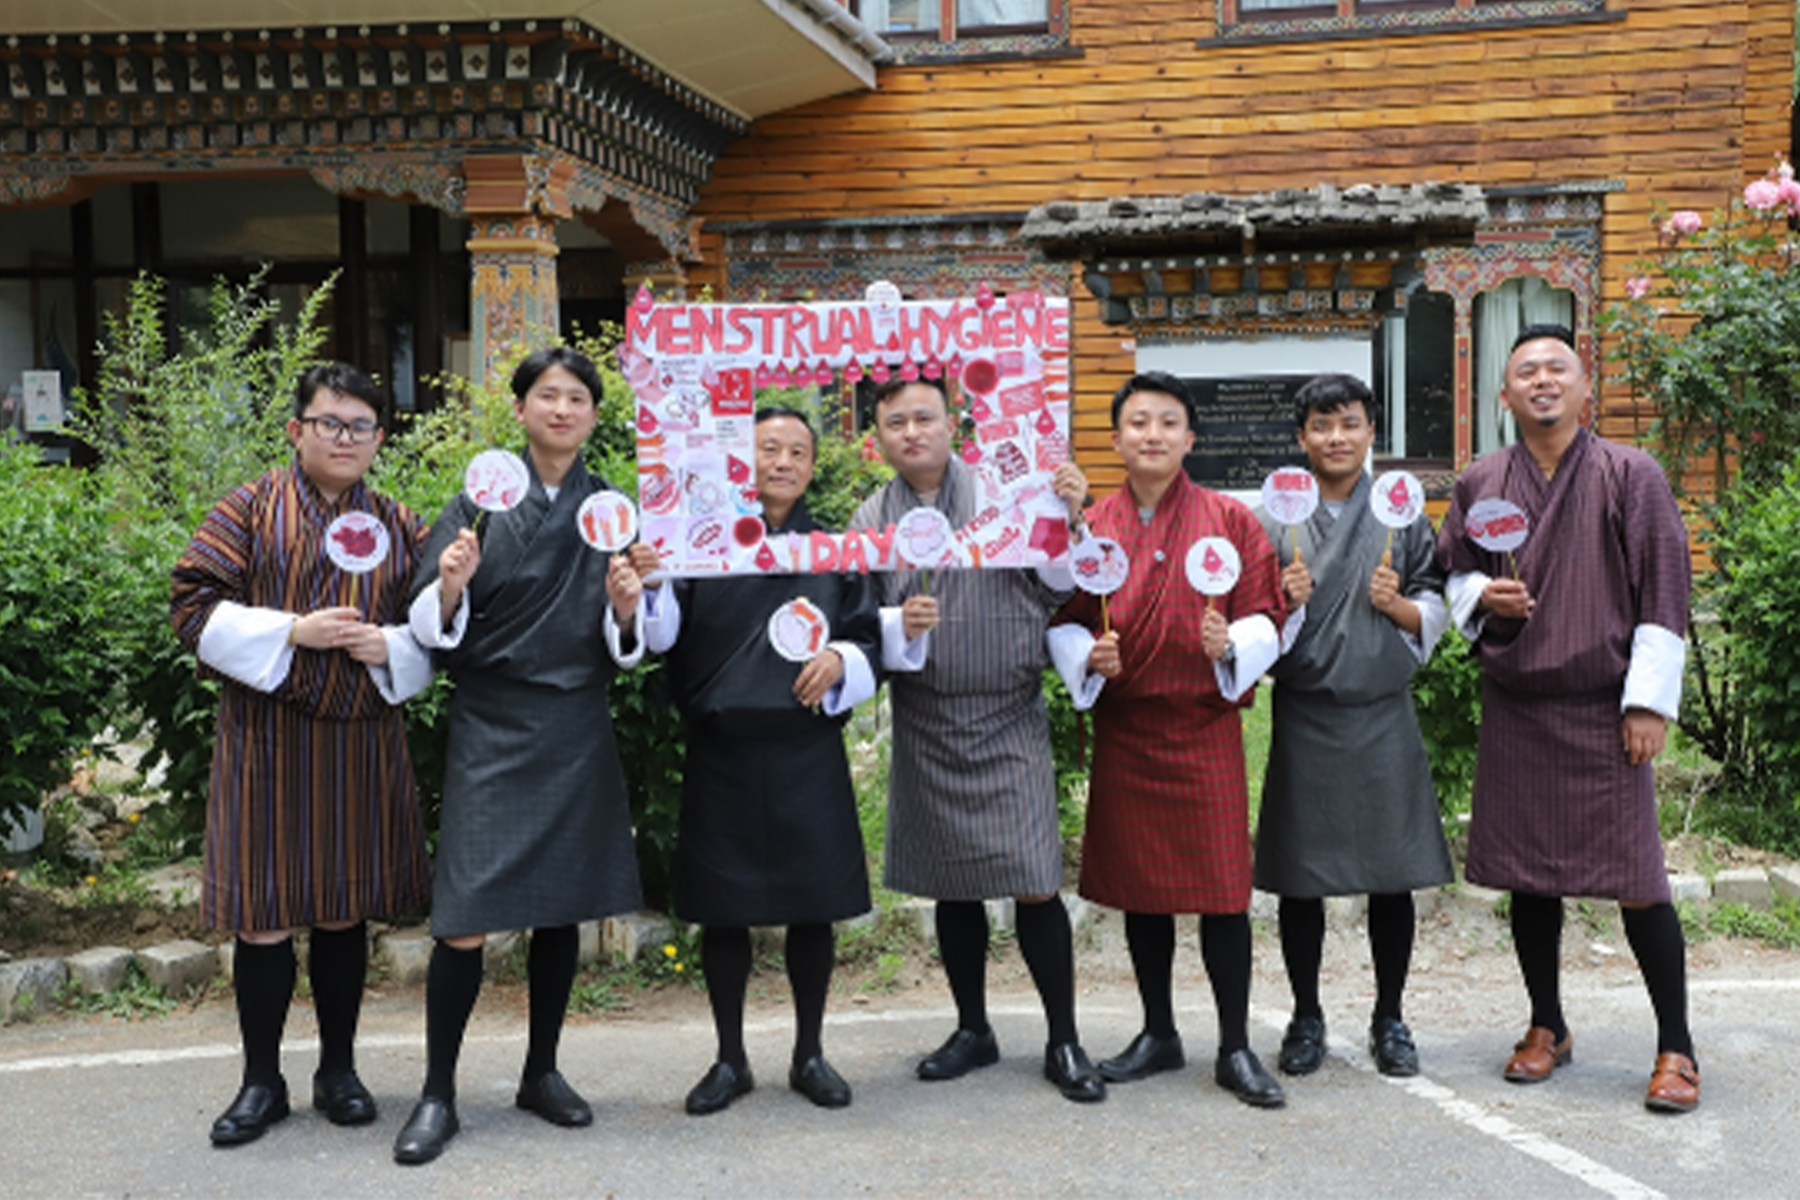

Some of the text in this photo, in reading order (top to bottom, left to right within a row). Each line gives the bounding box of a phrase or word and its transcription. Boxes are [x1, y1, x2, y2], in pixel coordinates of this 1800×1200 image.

[625, 300, 1069, 358] MENSTRUAL HYGIENE
[810, 522, 896, 575] DAY
